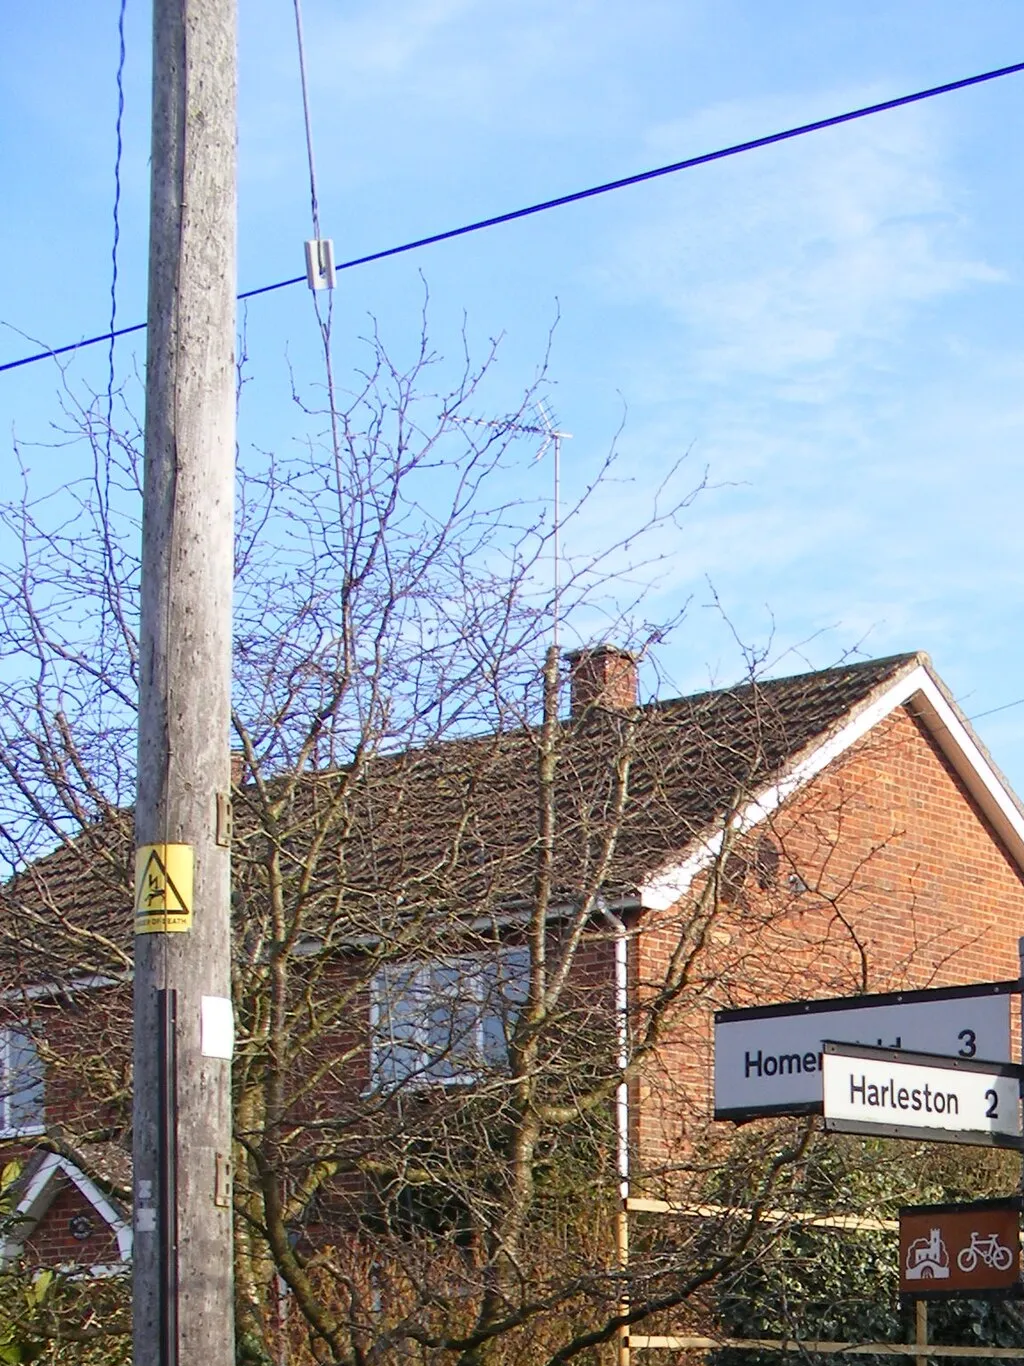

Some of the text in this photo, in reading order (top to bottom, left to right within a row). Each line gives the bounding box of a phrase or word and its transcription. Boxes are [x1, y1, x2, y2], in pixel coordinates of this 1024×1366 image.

[957, 1028, 977, 1058] 3
[849, 1074, 999, 1119] Harleston 2
